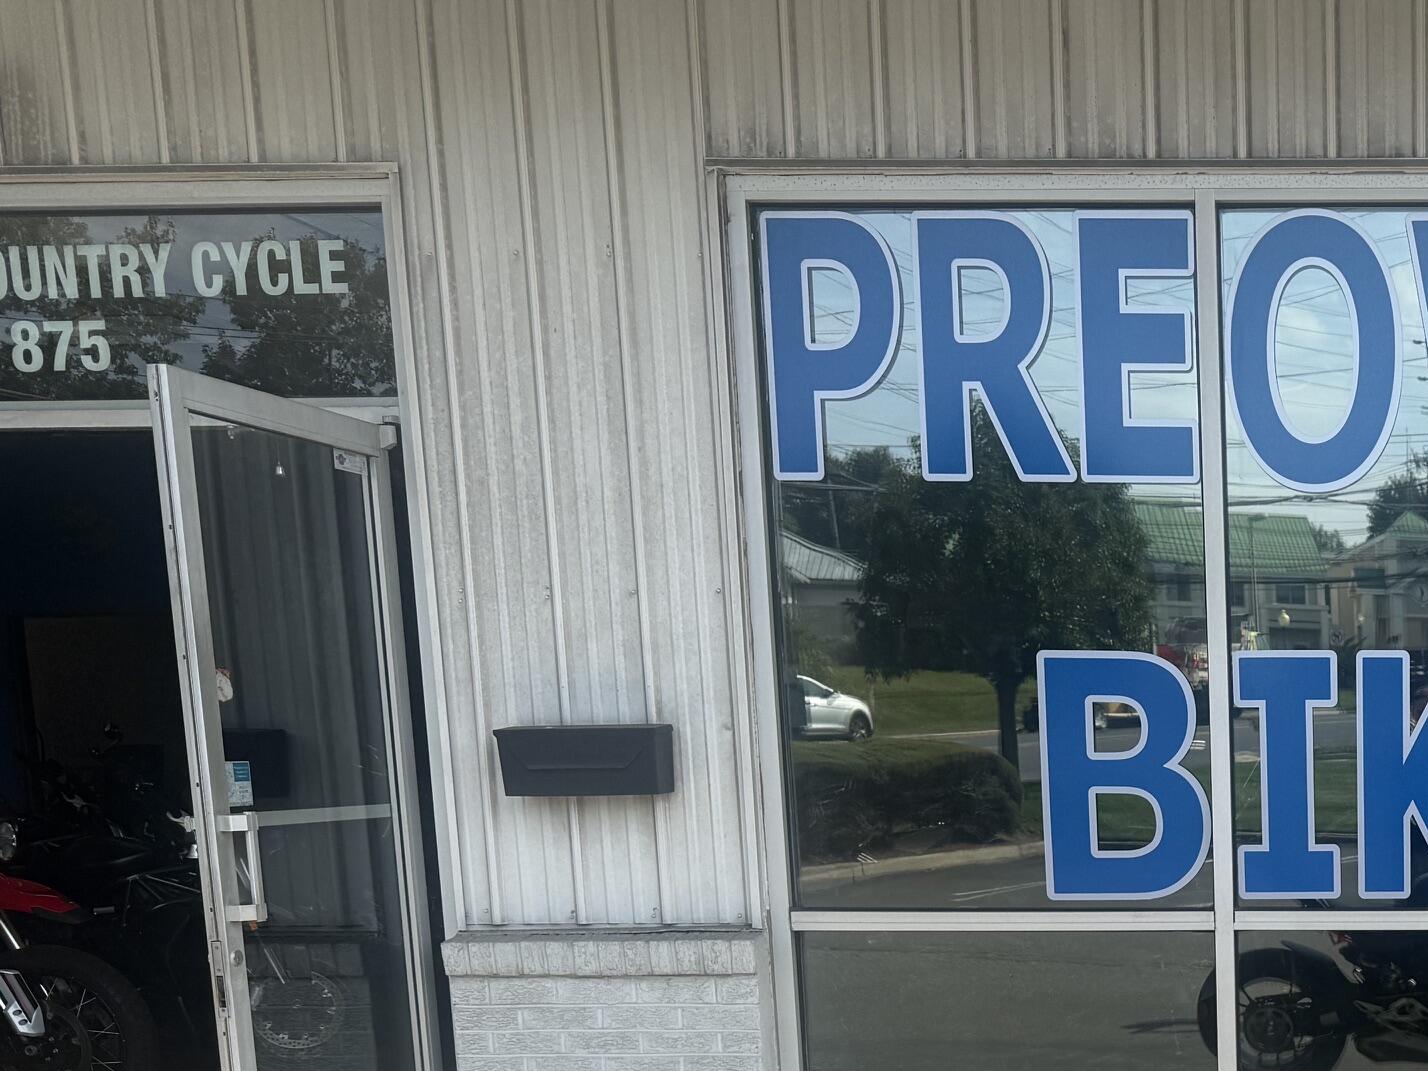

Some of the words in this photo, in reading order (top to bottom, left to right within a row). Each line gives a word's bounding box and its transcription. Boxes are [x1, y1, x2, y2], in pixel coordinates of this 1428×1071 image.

[0, 242, 171, 301] UNTRY
[191, 239, 350, 297] CYCLE
[10, 319, 111, 374] 875
